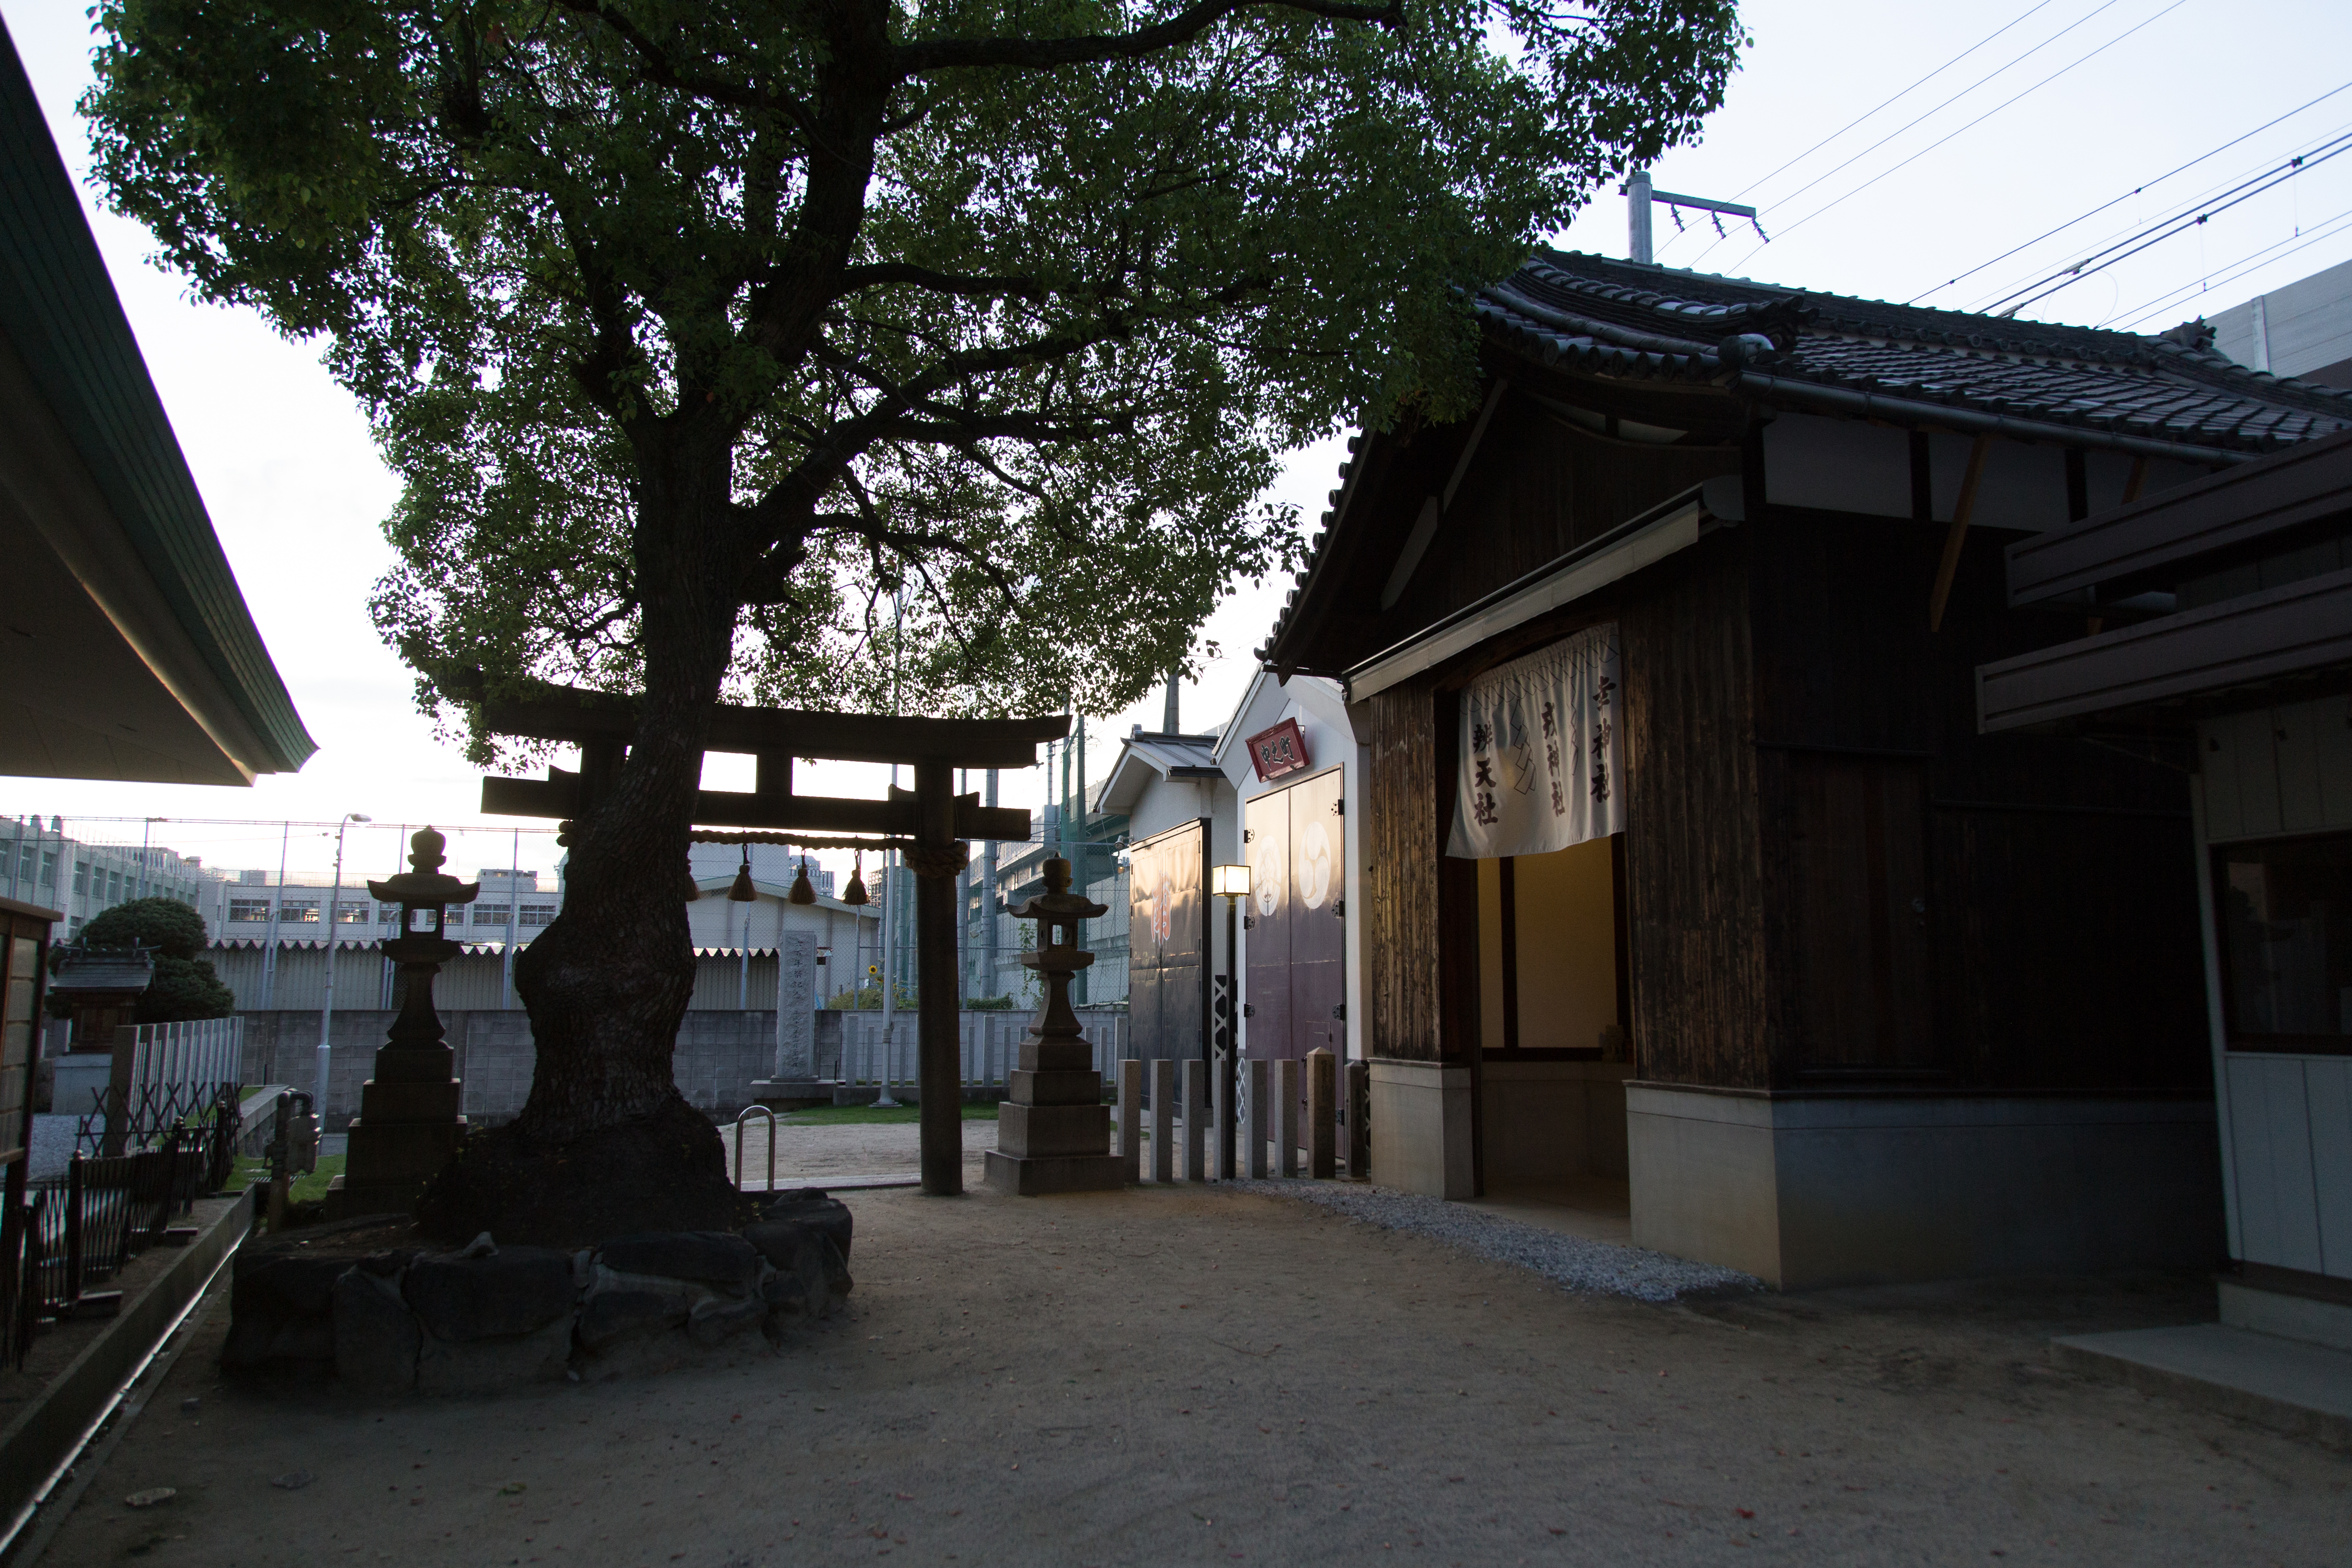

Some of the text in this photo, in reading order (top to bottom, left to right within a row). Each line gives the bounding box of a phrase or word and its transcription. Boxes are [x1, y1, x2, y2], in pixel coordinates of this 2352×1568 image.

[792, 941, 803, 999] 六百年祭記念
